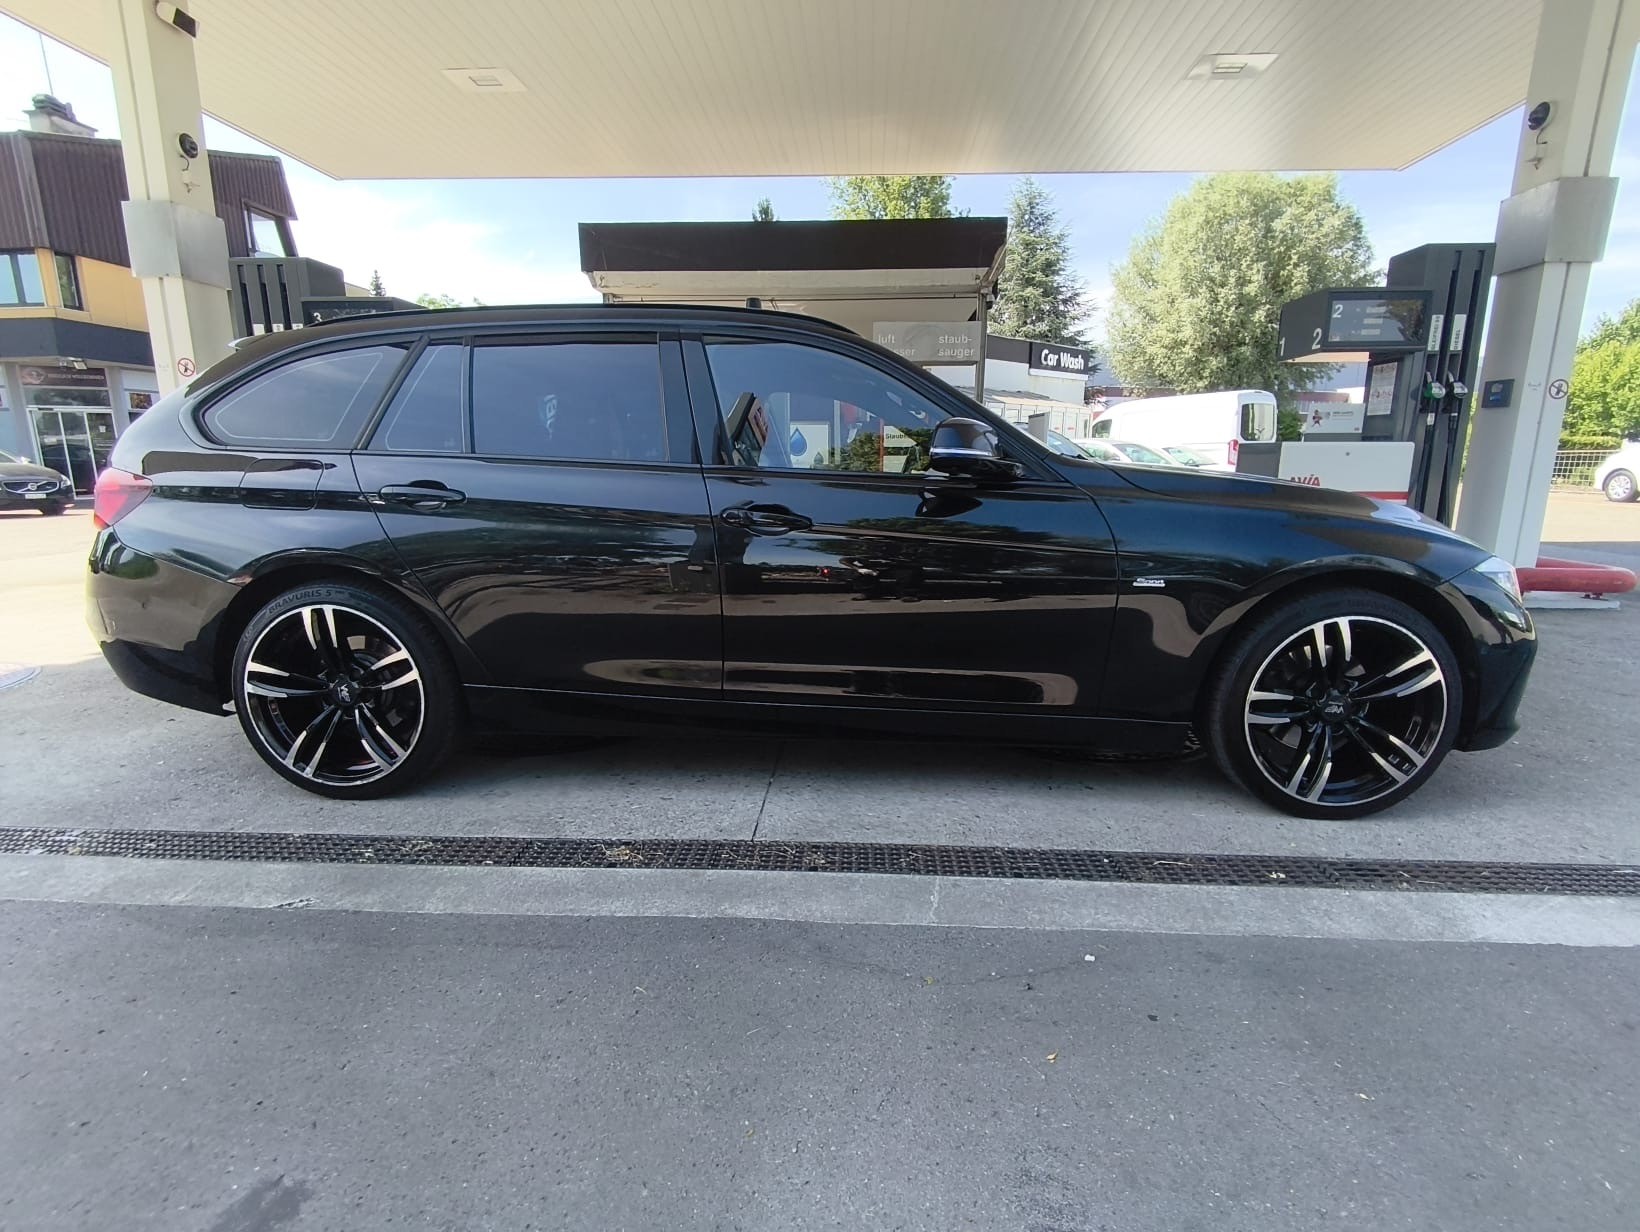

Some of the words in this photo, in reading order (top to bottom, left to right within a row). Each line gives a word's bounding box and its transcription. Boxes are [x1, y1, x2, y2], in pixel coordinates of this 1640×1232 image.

[1332, 304, 1343, 318] 2
[878, 334, 895, 344] luft
[938, 334, 973, 344] staub-
[1279, 337, 1286, 357] 1
[1311, 328, 1322, 350] 2
[1453, 329, 1461, 350] DIESEL
[938, 348, 975, 358] sauger
[1041, 349, 1059, 367] Car
[1060, 352, 1085, 370] Wash
[268, 589, 321, 614] BRAVURIS
[325, 589, 333, 597] 5
